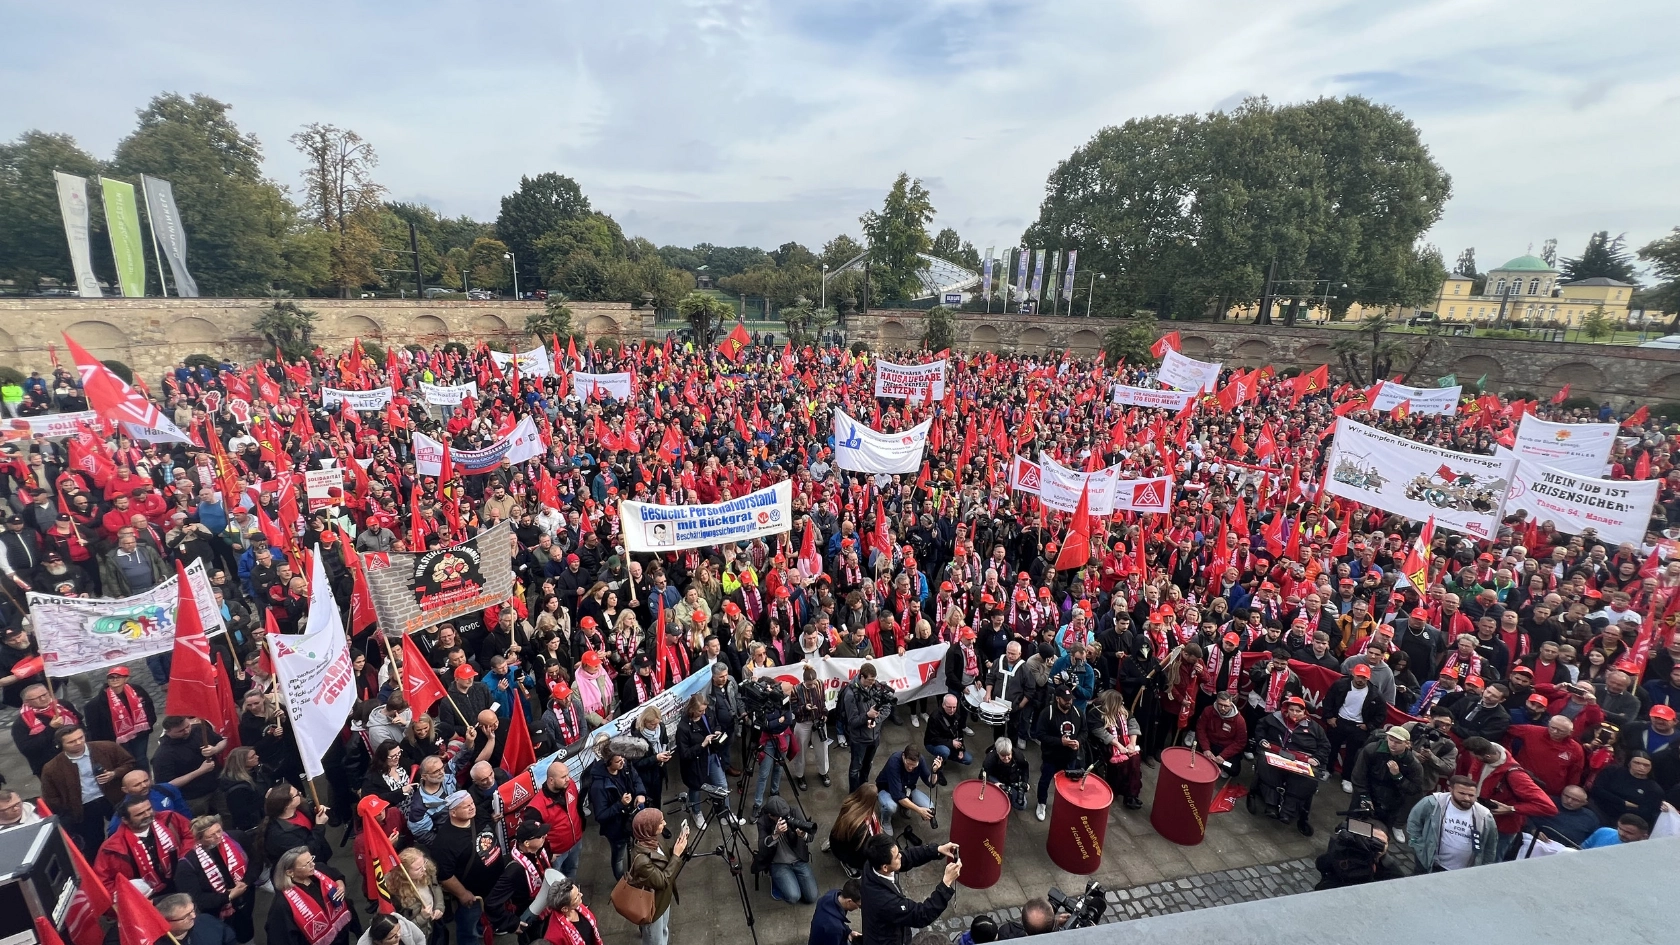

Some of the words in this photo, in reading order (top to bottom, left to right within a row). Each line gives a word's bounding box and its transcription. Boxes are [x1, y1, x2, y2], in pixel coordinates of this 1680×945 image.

[880, 372, 942, 383] HAUSAUFGABE
[882, 386, 916, 396] SETZEN!
[1348, 425, 1362, 434] Wir
[1364, 430, 1395, 444] kämpfen
[1398, 439, 1408, 448] für
[1410, 444, 1438, 456] unsere
[1440, 450, 1502, 469] Tarifverträge!
[308, 474, 340, 482] SOLIDARITÄT
[1046, 466, 1060, 476] Durch
[1541, 472, 1576, 488] "MEIN
[1605, 488, 1630, 498] IST
[1054, 494, 1074, 504] können
[1530, 482, 1634, 512] KRISENSICHER!"
[640, 505, 688, 521] Gesucht:
[689, 488, 778, 518] Personalvorstand
[1056, 500, 1074, 510] endlich
[1536, 498, 1565, 513] Thomas
[1584, 512, 1624, 526] Manager
[678, 520, 697, 530] mit
[700, 512, 752, 528] Rückgrat
[676, 526, 745, 541] Beschäftigungssicherung
[415, 561, 428, 578] WIR
[424, 549, 446, 564] STEHEN
[448, 546, 481, 564] ZUSAMMEN
[186, 564, 202, 576] an
[888, 676, 910, 690] ZU!
[1444, 828, 1472, 840] NOTHIN
[1070, 826, 1090, 860] sicherung
